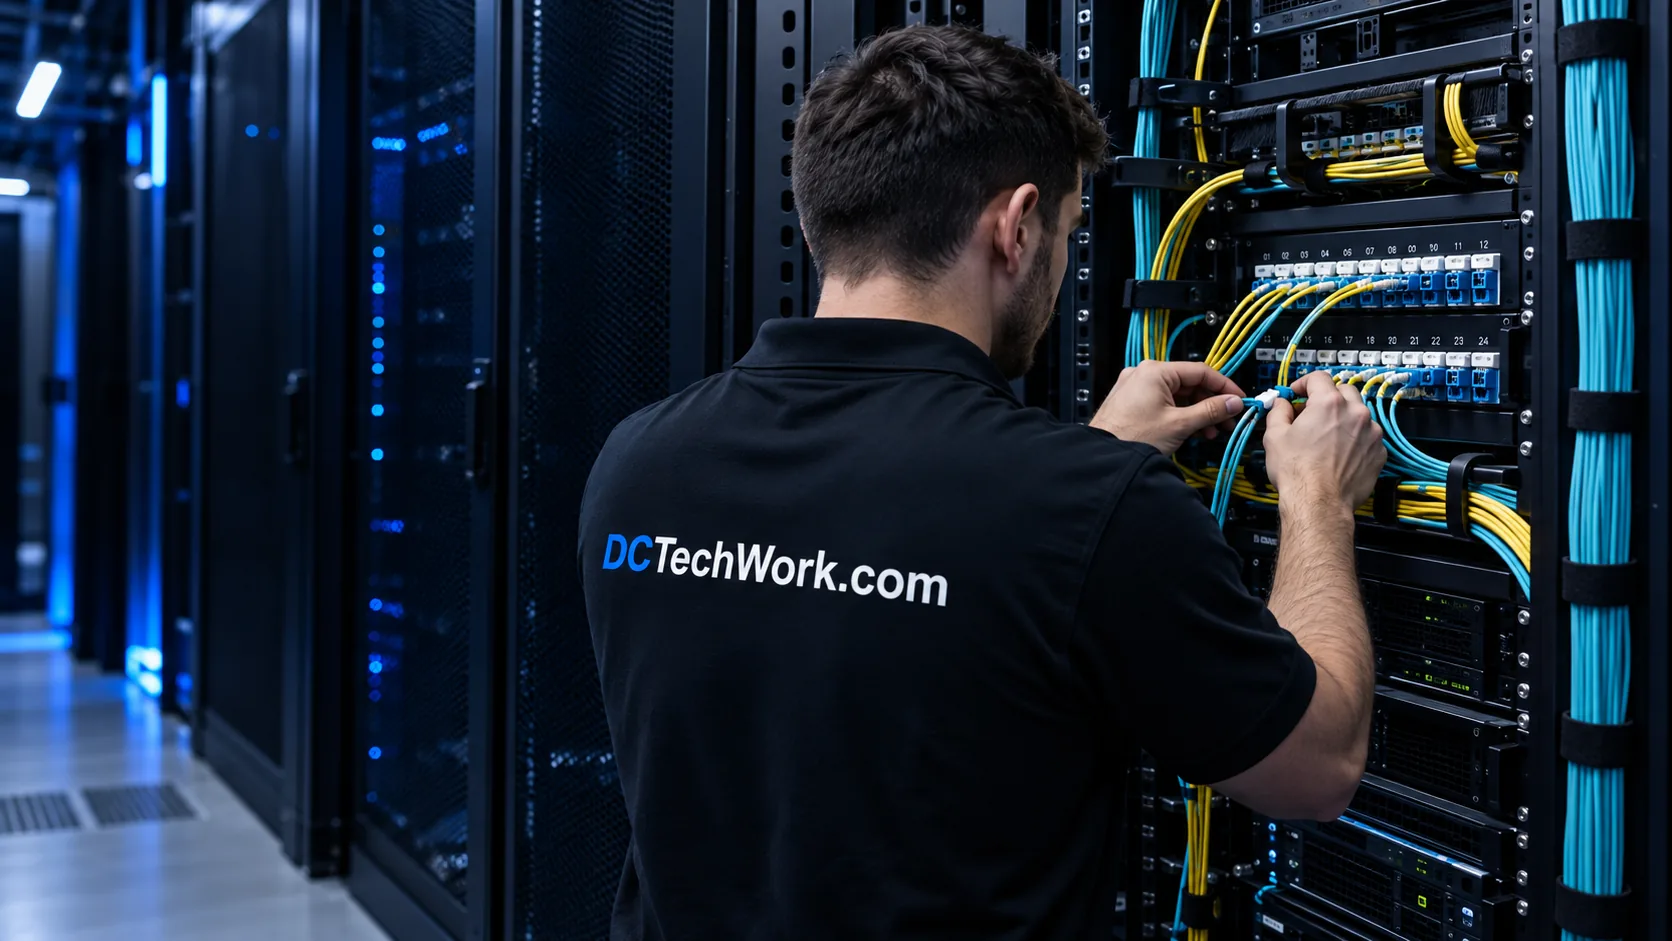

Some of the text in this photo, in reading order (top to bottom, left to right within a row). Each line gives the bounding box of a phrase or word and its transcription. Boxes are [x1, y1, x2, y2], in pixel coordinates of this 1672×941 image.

[1263, 253, 1271, 261] 01
[1281, 251, 1290, 260] 02
[1320, 249, 1330, 258] 04
[1365, 246, 1375, 255] 07
[1387, 245, 1398, 254] 08
[1454, 242, 1462, 250] 11
[1479, 239, 1489, 249] 12
[1324, 335, 1333, 344] 16
[1344, 335, 1354, 344] 17
[1366, 336, 1376, 345] 18
[1409, 336, 1419, 345] 21
[1431, 336, 1441, 346] 22
[1454, 336, 1464, 346] 23
[1478, 336, 1489, 346] 24
[602, 533, 948, 607] DCTechWork.com
